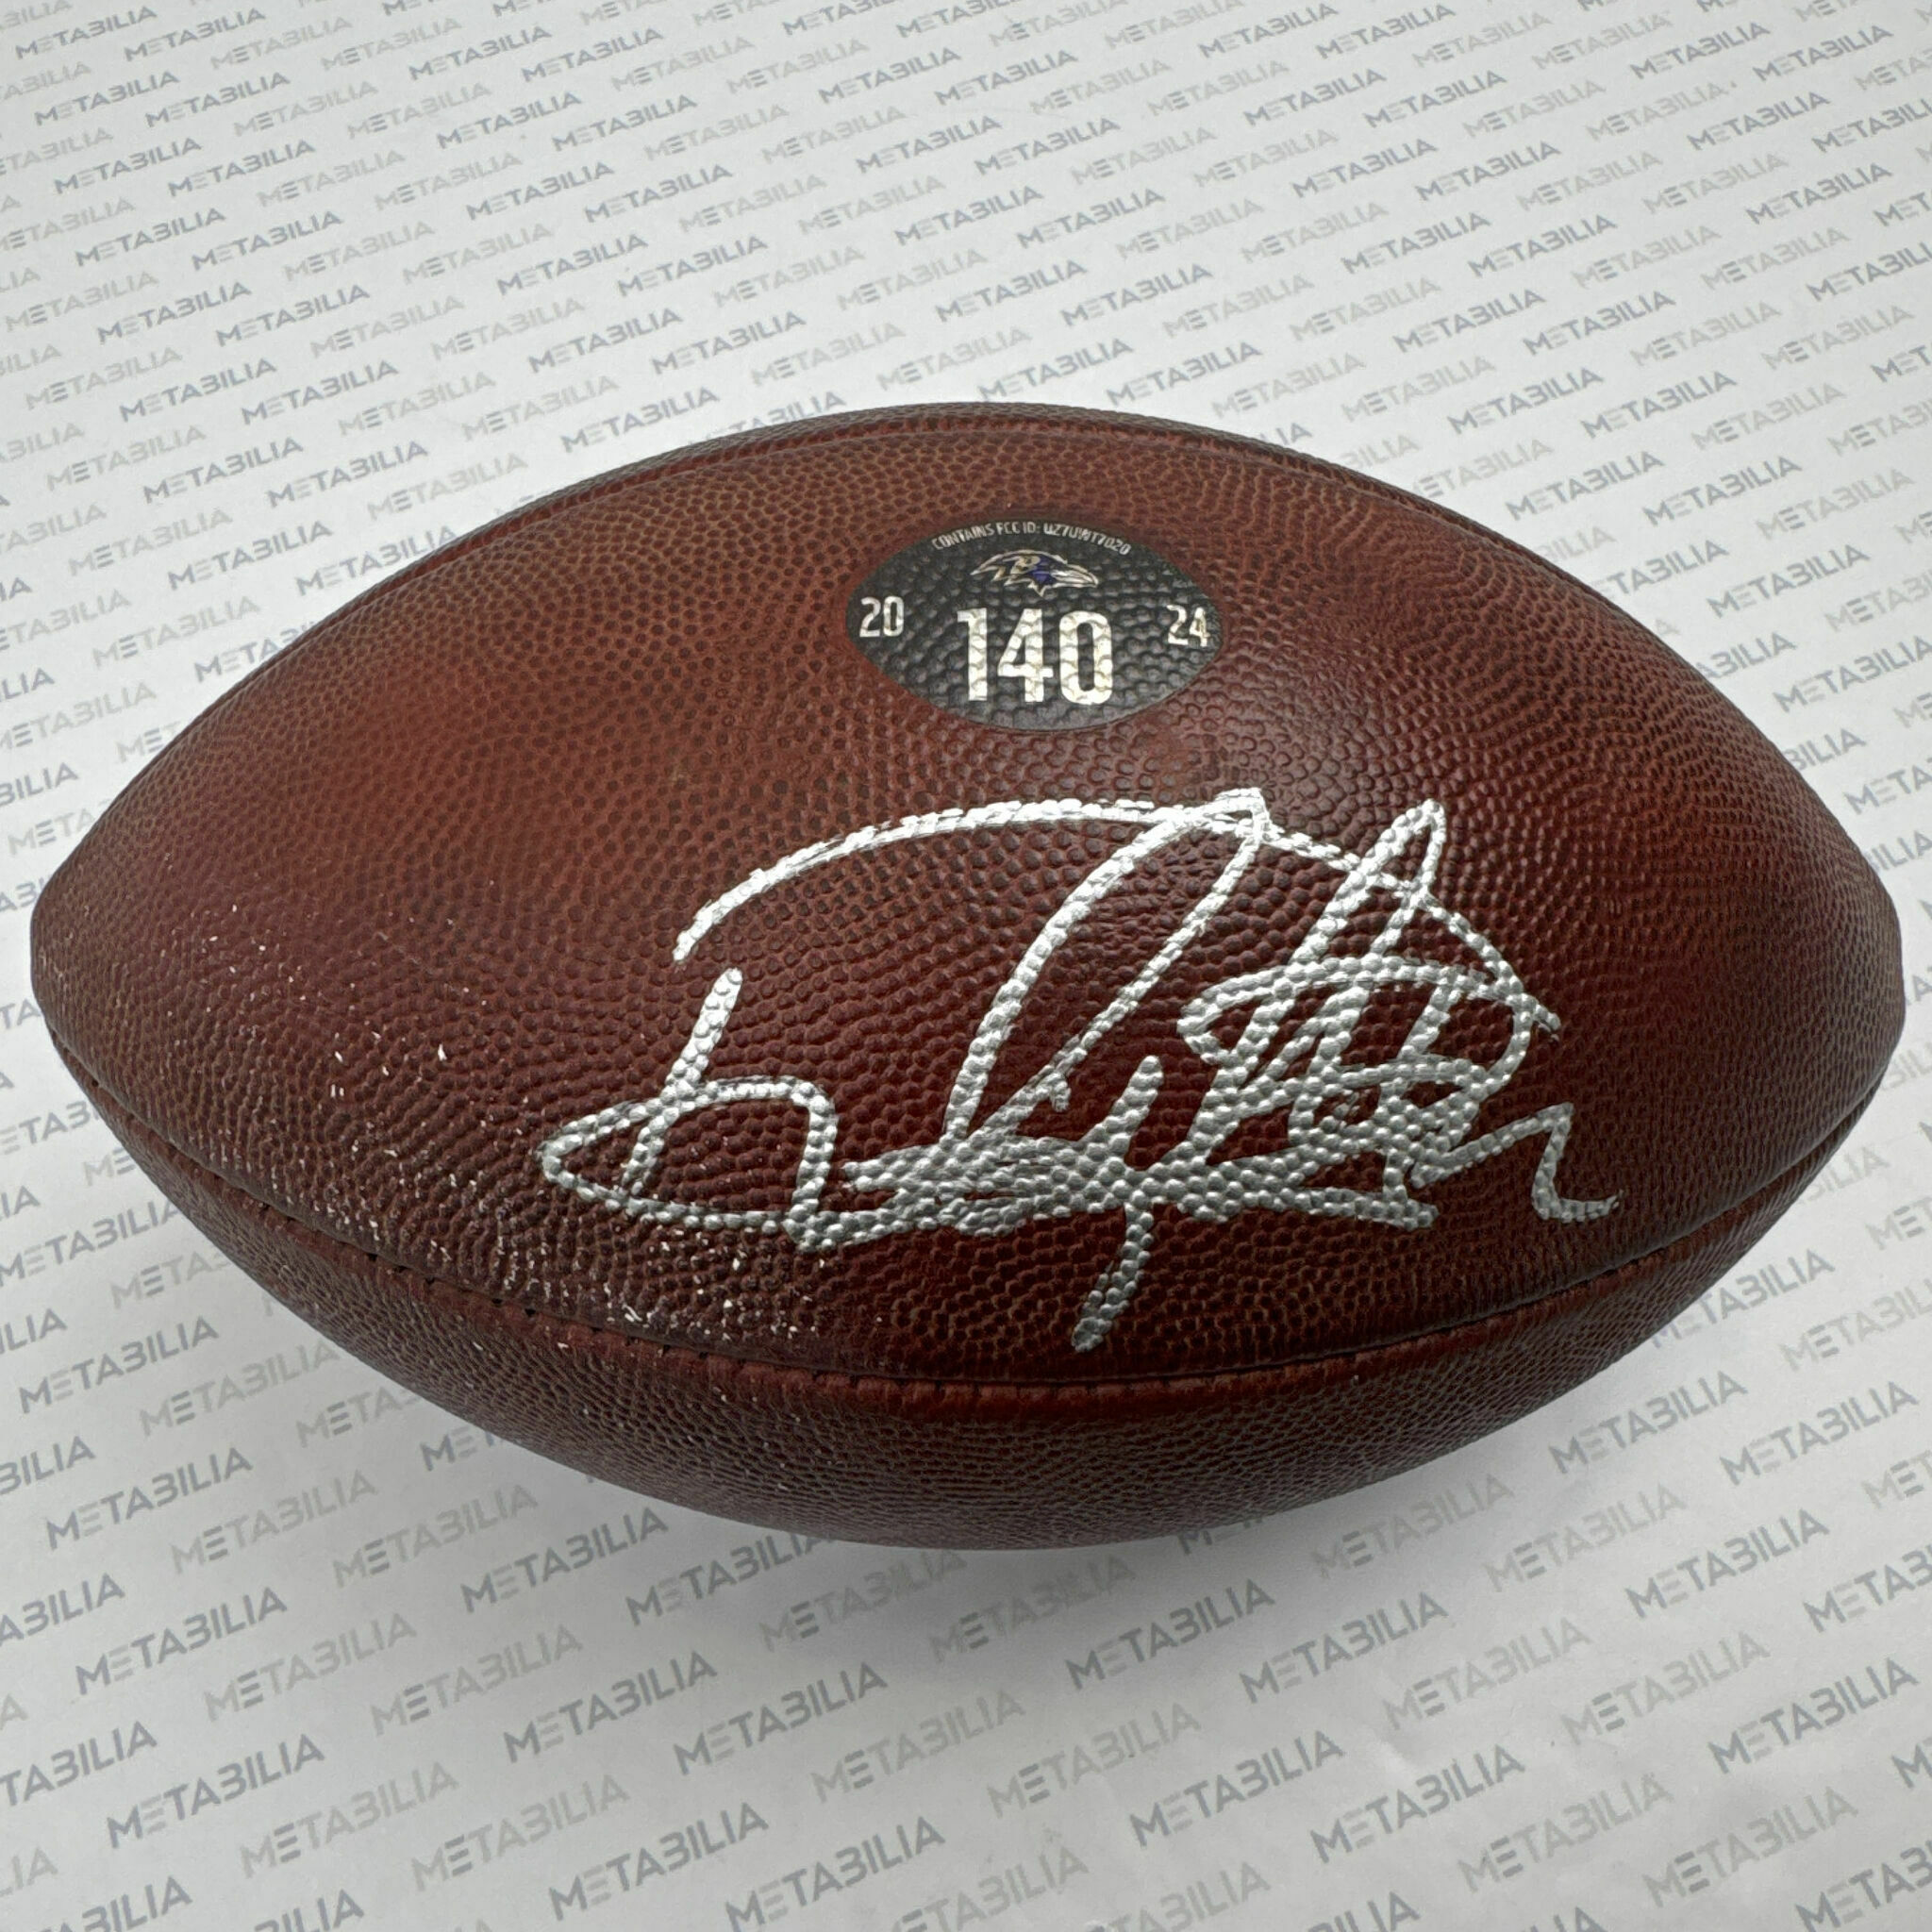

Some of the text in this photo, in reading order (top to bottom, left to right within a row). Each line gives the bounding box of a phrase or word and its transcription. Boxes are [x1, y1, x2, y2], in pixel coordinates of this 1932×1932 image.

[15, 6, 158, 60] METABILIA
[124, 8, 267, 62] METABILIA
[210, 17, 353, 70] METABILIA
[321, 18, 462, 71] METABILIA
[408, 25, 553, 81] METABILIA
[521, 27, 665, 83] METABILIA
[1197, 3, 1340, 58] METABILIA
[1315, 3, 1457, 59] METABILIA
[1412, 12, 1552, 68] METABILIA
[1531, 14, 1673, 70] METABILIA
[1628, 22, 1772, 80] METABILIA
[1752, 25, 1894, 82] METABILIA
[610, 36, 755, 92] METABILIA
[726, 39, 869, 94] METABILIA
[818, 47, 962, 105] METABILIA
[934, 50, 1079, 106] METABILIA
[1029, 59, 1172, 115] METABILIA
[1147, 60, 1290, 116] METABILIA
[34, 71, 180, 126] METABILIA
[144, 72, 291, 128] METABILIA
[233, 81, 378, 137] METABILIA
[347, 83, 492, 140] METABILIA
[436, 92, 583, 150] METABILIA
[551, 94, 698, 152] METABILIA
[1242, 68, 1387, 127] METABILIA
[1362, 70, 1507, 128] METABILIA
[1462, 80, 1606, 139] METABILIA
[1586, 81, 1737, 141] METABILIA
[1686, 92, 1831, 151] METABILIA
[643, 105, 790, 161] METABILIA
[761, 107, 907, 164] METABILIA
[855, 115, 1003, 175] METABILIA
[974, 117, 1121, 176] METABILIA
[1070, 127, 1217, 186] METABILIA
[1192, 129, 1339, 188] METABILIA
[53, 137, 203, 195] METABILIA
[167, 140, 316, 198] METABILIA
[257, 150, 406, 208] METABILIA
[375, 153, 523, 211] METABILIA
[465, 161, 615, 221] METABILIA
[583, 164, 734, 224] METABILIA
[1290, 138, 1439, 199] METABILIA
[1413, 141, 1562, 202] METABILIA
[1516, 152, 1663, 211] METABILIA
[1641, 154, 1789, 214] METABILIA
[1744, 162, 1893, 225] METABILIA
[678, 175, 826, 233] METABILIA
[797, 175, 946, 235] METABILIA
[893, 185, 1044, 246] METABILIA
[1015, 188, 1166, 249] METABILIA
[1115, 198, 1265, 260] METABILIA
[1241, 202, 1389, 263] METABILIA
[75, 208, 226, 268] METABILIA
[192, 210, 344, 272] METABILIA
[283, 222, 435, 282] METABILIA
[403, 224, 554, 285] METABILIA
[496, 233, 649, 296] METABILIA
[616, 235, 769, 298] METABILIA
[1341, 212, 1492, 275] METABILIA
[1467, 214, 1618, 278] METABILIA
[1571, 225, 1722, 289] METABILIA
[1700, 227, 1851, 291] METABILIA
[5, 271, 158, 332] METABILIA
[713, 246, 865, 308] METABILIA
[837, 249, 988, 311] METABILIA
[934, 259, 1089, 324] METABILIA
[1059, 263, 1214, 328] METABILIA
[1162, 275, 1315, 338] METABILIA
[1289, 277, 1442, 341] METABILIA
[96, 280, 253, 345] METABILIA
[215, 284, 371, 347] METABILIA
[310, 295, 465, 358] METABILIA
[431, 297, 586, 360] METABILIA
[526, 308, 684, 375] METABILIA
[650, 310, 807, 375] METABILIA
[1391, 289, 1547, 354] METABILIA
[1522, 291, 1676, 357] METABILIA
[1629, 302, 1782, 367] METABILIA
[1760, 306, 1915, 371] METABILIA
[25, 347, 182, 410] METABILIA
[751, 323, 906, 387] METABILIA
[876, 327, 1032, 391] METABILIA
[978, 338, 1136, 401] METABILIA
[1107, 342, 1263, 408] METABILIA
[1211, 353, 1366, 419] METABILIA
[119, 358, 277, 423] METABILIA
[241, 359, 400, 425] METABILIA
[338, 372, 496, 436] METABILIA
[461, 375, 620, 441] METABILIA
[559, 386, 721, 454] METABILIA
[1341, 356, 1496, 423] METABILIA
[1446, 367, 1605, 436] METABILIA
[1579, 371, 1739, 440] METABILIA
[1690, 383, 1846, 450] METABILIA
[46, 425, 207, 491] METABILIA
[142, 437, 305, 505] METABILIA
[265, 441, 430, 509] METABILIA
[367, 453, 528, 521] METABILIA
[1505, 451, 1666, 522] METABILIA
[1641, 456, 1804, 527] METABILIA
[1756, 469, 1915, 541] METABILIA
[68, 508, 233, 576] METABILIA
[167, 520, 334, 591] METABILIA
[295, 525, 458, 597] METABILIA
[931, 523, 995, 550] CONTAINS
[996, 521, 1021, 536] FCC
[1023, 521, 1041, 535] ID:
[1706, 544, 1872, 619] METABILIA
[92, 596, 261, 669] METABILIA
[858, 595, 906, 638] 20
[1166, 605, 1211, 648] 24
[957, 607, 1113, 706] 140
[1772, 636, 1932, 713] METABILIA
[18, 1316, 220, 1415] METABILIA
[141, 1340, 341, 1436] METABILIA
[1548, 1371, 1749, 1474] METABILIA
[1719, 1381, 1920, 1487] METABILIA
[43, 1446, 253, 1551] METABILIA
[171, 1470, 377, 1574] METABILIA
[1312, 1474, 1514, 1578] METABILIA
[333, 1485, 538, 1588] METABILIA
[460, 1507, 669, 1614] METABILIA
[1483, 1484, 1688, 1592] METABILIA
[1624, 1508, 1830, 1620] METABILIA
[625, 1532, 835, 1627] METABILIA
[759, 1551, 966, 1652] METABILIA
[930, 1556, 1136, 1663] METABILIA
[75, 1587, 288, 1696] METABILIA
[1065, 1579, 1276, 1691] METABILIA
[1239, 1591, 1449, 1704] METABILIA
[204, 1613, 417, 1723] METABILIA
[371, 1625, 583, 1736] METABILIA
[1381, 1618, 1592, 1731] METABILIA
[1559, 1631, 1772, 1745] METABILIA
[503, 1650, 718, 1764] METABILIA
[673, 1661, 888, 1776] METABILIA
[1707, 1657, 1920, 1774] METABILIA
[811, 1690, 1025, 1804] METABILIA
[987, 1704, 1201, 1818] METABILIA
[106, 1734, 325, 1850] METABILIA
[240, 1762, 458, 1878] METABILIA
[1128, 1730, 1346, 1848] METABILIA
[1309, 1744, 1526, 1865] METABILIA
[411, 1774, 630, 1891] METABILIA
[548, 1802, 770, 1922] METABILIA
[1457, 1773, 1674, 1892] METABILIA
[1642, 1787, 1858, 1907] METABILIA
[724, 1816, 946, 1932] METABILIA
